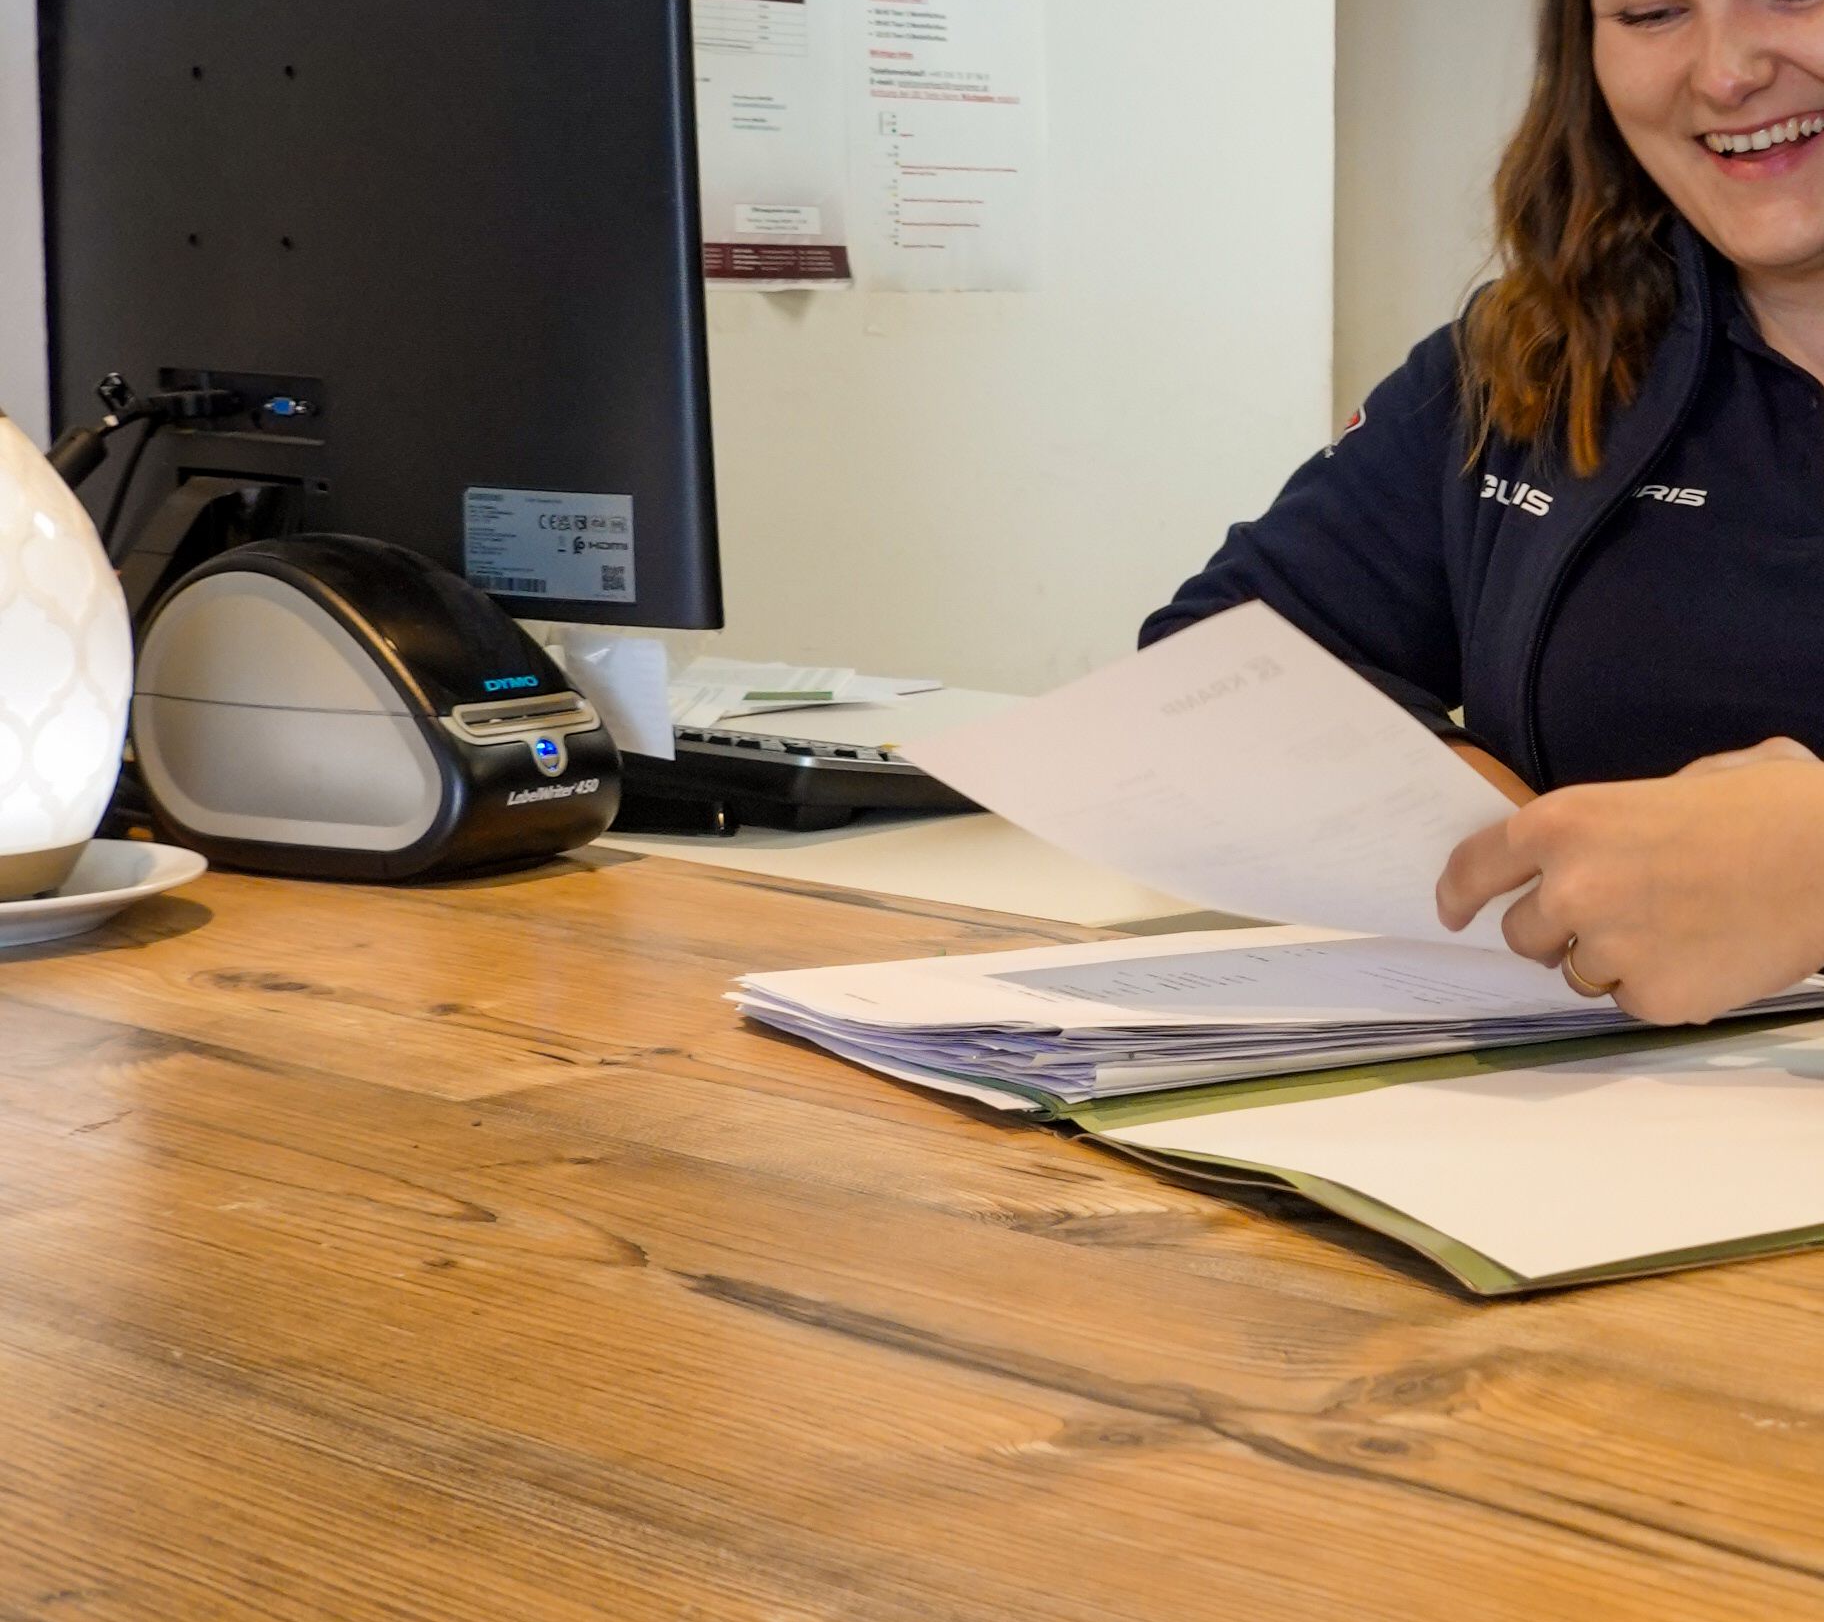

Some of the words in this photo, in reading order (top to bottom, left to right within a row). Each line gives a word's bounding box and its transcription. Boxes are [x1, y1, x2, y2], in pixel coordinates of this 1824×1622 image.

[484, 675, 539, 692] DYMO
[506, 783, 575, 806] LabelWriter
[575, 778, 600, 795] 450
